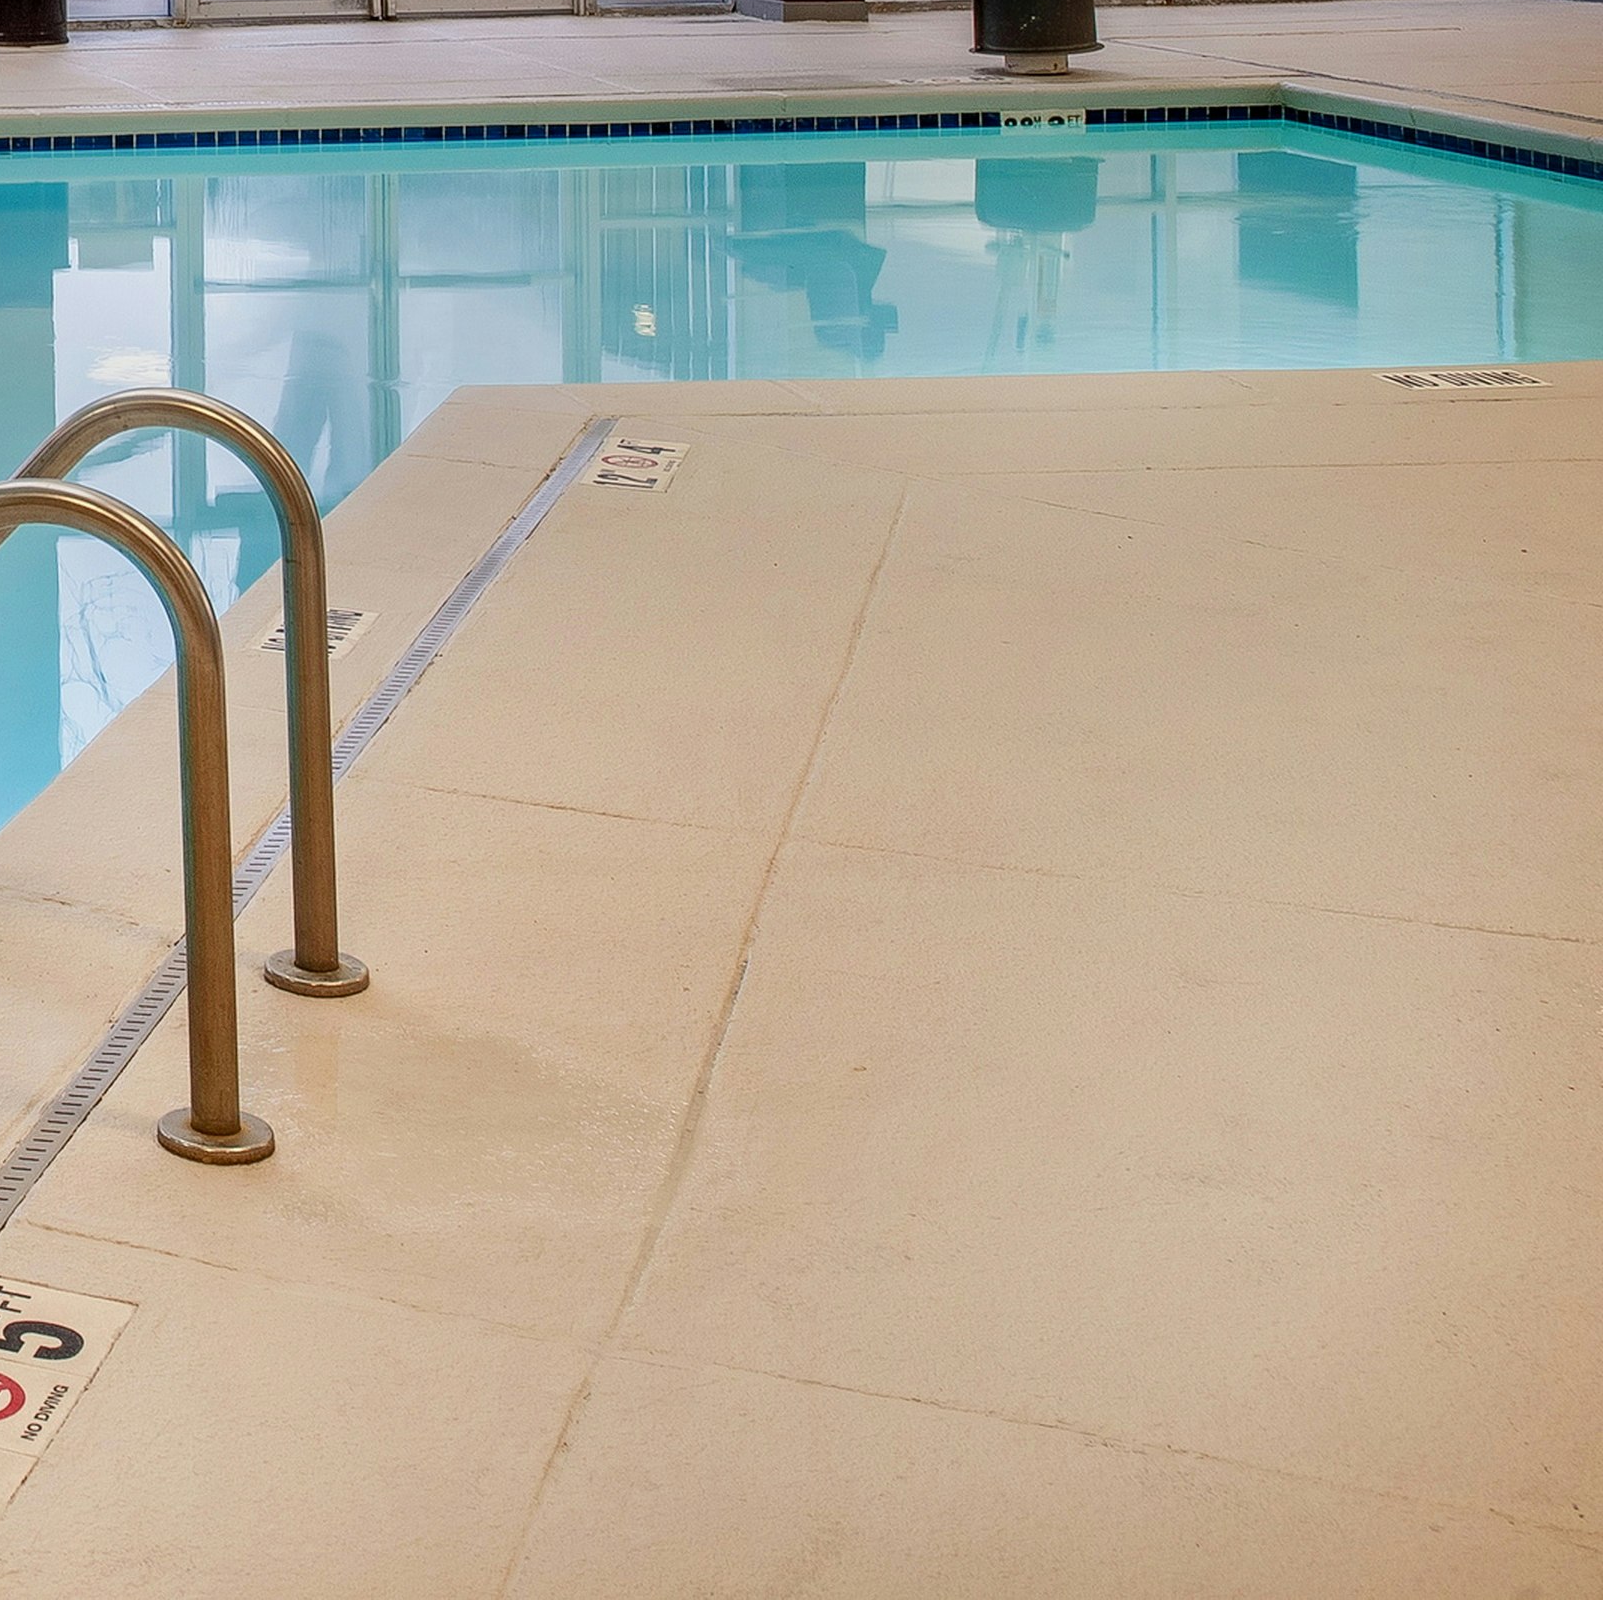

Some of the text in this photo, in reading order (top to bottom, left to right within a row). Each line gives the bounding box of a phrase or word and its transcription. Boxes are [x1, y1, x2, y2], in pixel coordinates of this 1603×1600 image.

[1382, 371, 1541, 388] NO DIVING
[20, 1384, 69, 1442] NO DIVING
